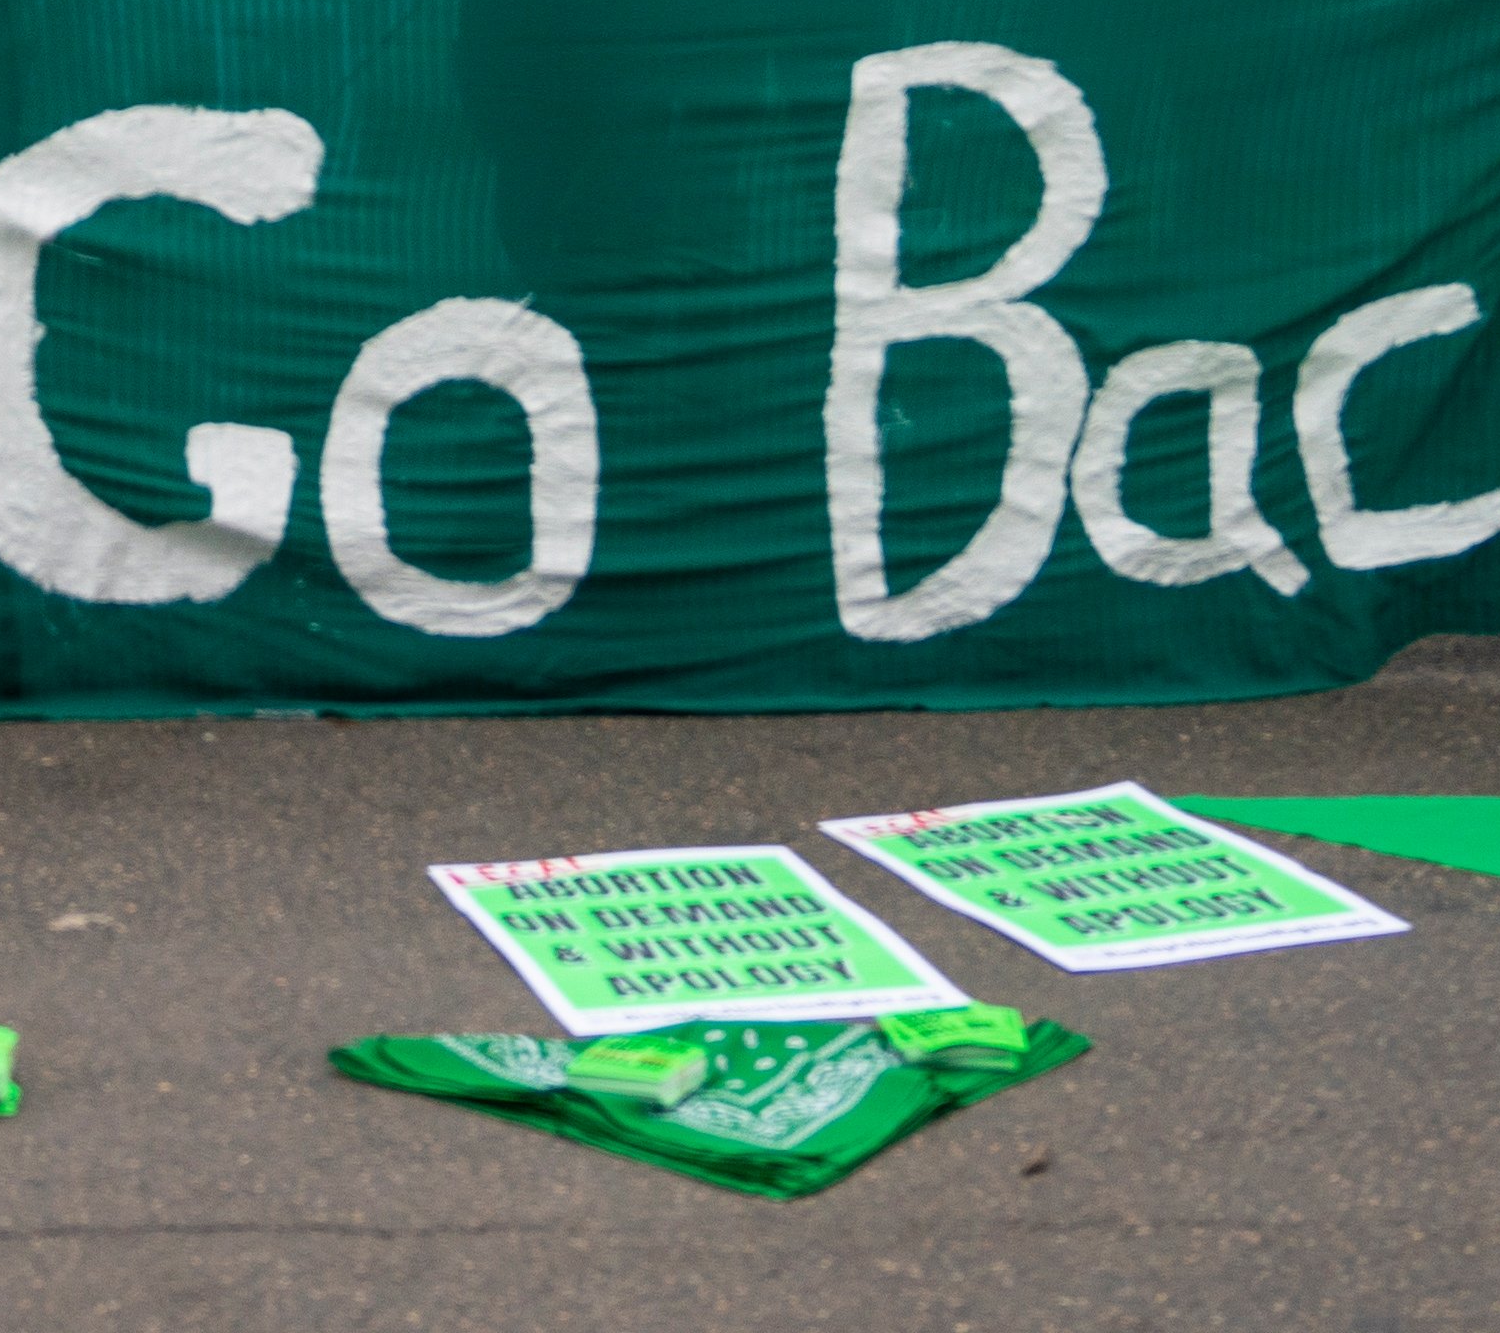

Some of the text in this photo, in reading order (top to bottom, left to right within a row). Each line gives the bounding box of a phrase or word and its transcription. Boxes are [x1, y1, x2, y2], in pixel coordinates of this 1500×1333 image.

[900, 804, 1136, 851] ABORTION
[918, 827, 1214, 883] ON DEMAND
[506, 863, 765, 904] ABORTION
[986, 854, 1252, 911] & WITHOUT
[500, 892, 828, 934] ON DEMAND
[1057, 887, 1288, 937] APOLOGY
[553, 925, 848, 965] & WITHOUT
[608, 960, 858, 1000] APOLOGY
